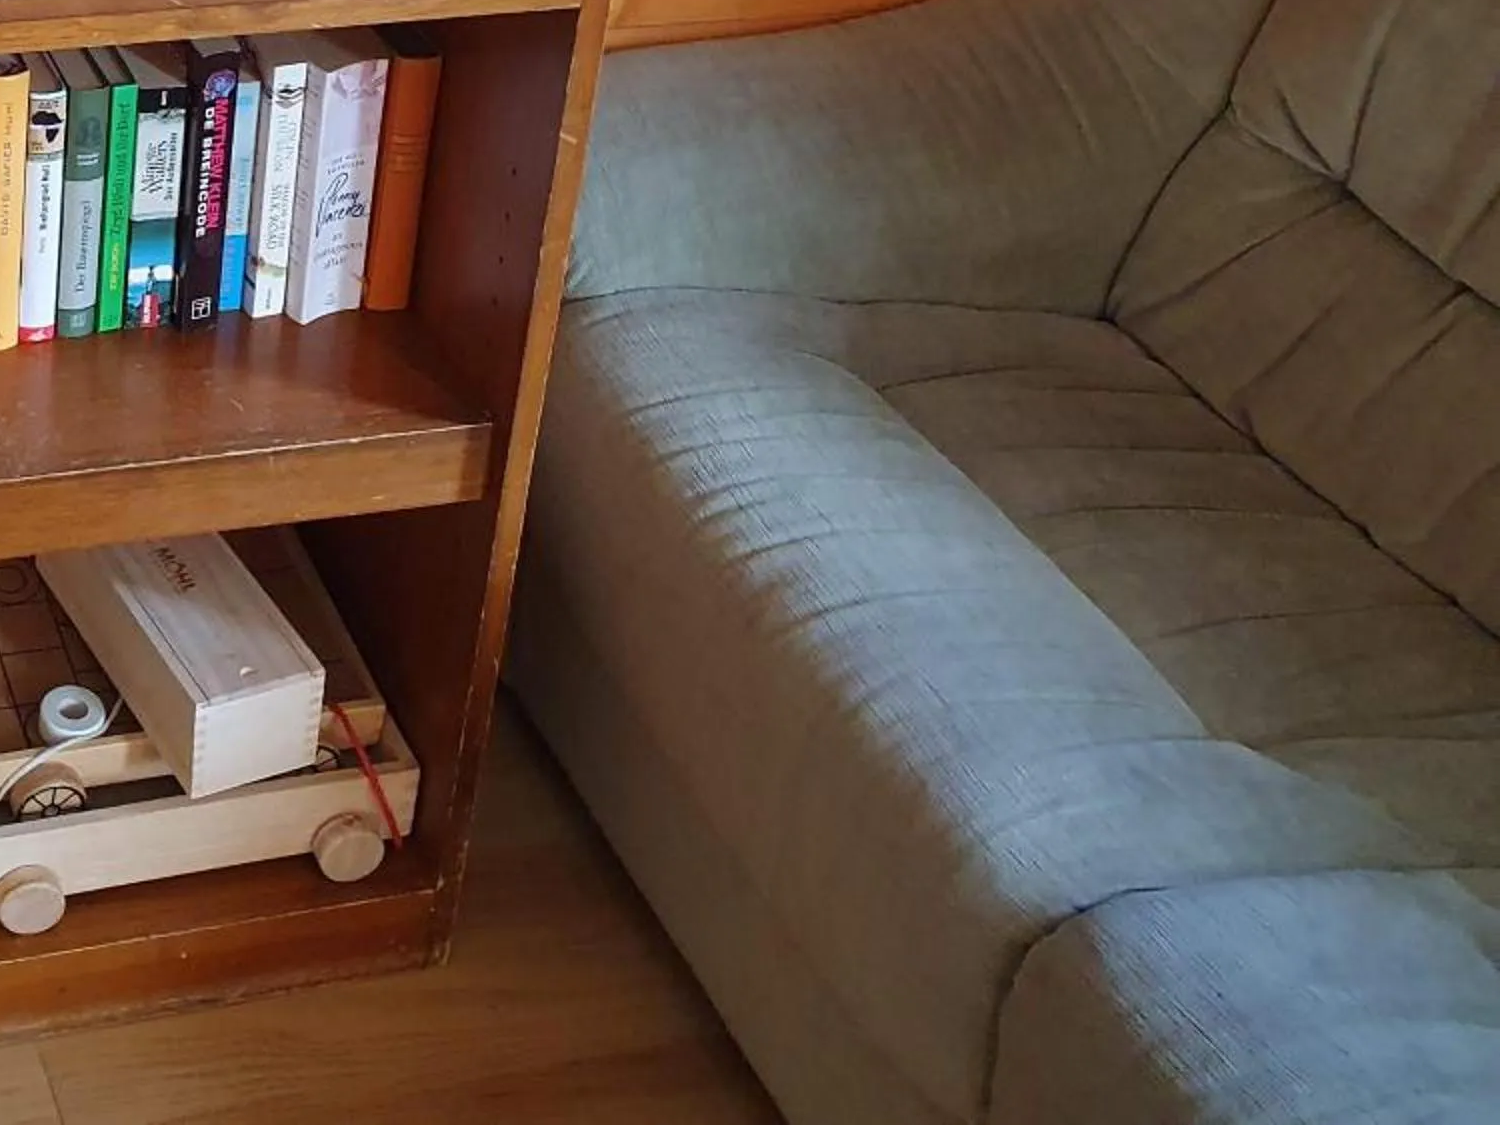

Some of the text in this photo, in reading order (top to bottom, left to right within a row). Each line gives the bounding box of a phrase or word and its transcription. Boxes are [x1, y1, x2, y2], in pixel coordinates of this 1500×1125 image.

[203, 107, 215, 130] DE
[211, 98, 229, 179] MATTHEW
[195, 137, 213, 238] BREINCODE
[206, 181, 223, 229] KLEIN
